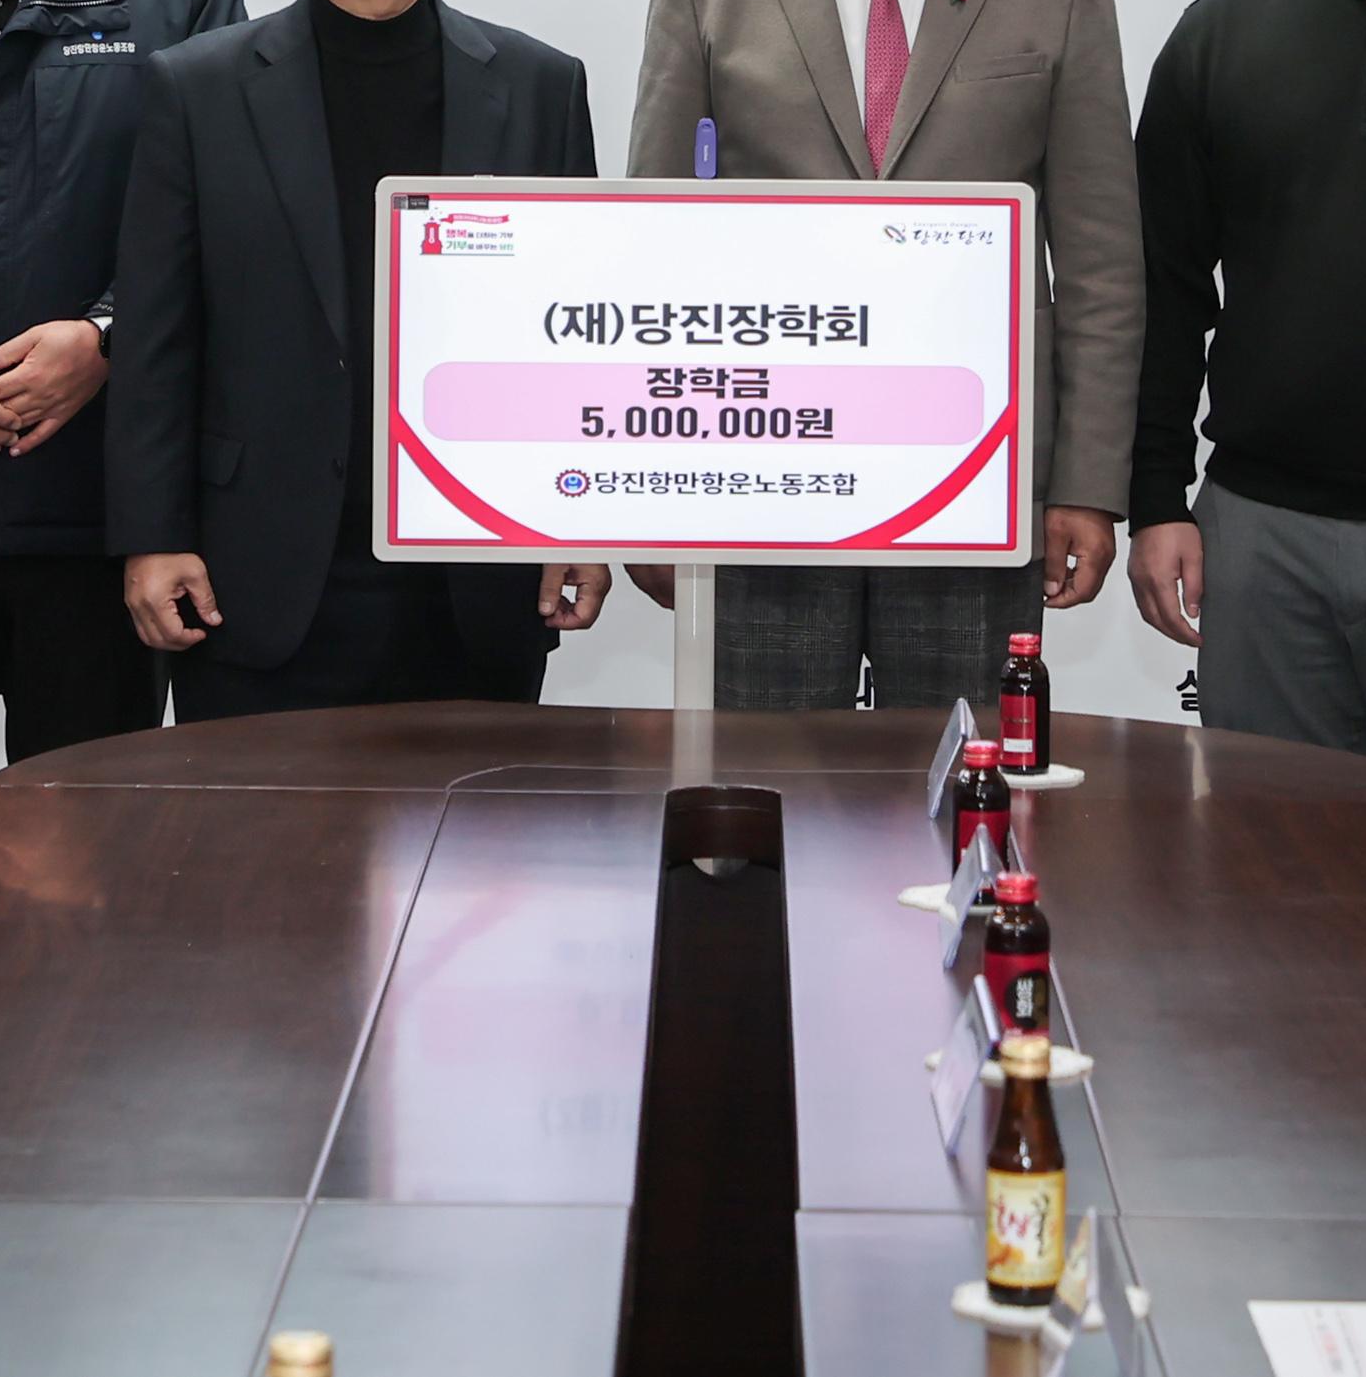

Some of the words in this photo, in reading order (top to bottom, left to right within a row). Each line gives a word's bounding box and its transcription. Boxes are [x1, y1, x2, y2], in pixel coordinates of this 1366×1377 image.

[544, 302, 869, 347] (재)당진장학회
[646, 367, 770, 400] 장학금
[581, 406, 834, 440] 5,000,000원
[594, 470, 858, 497] 당진항만항운노동조합
